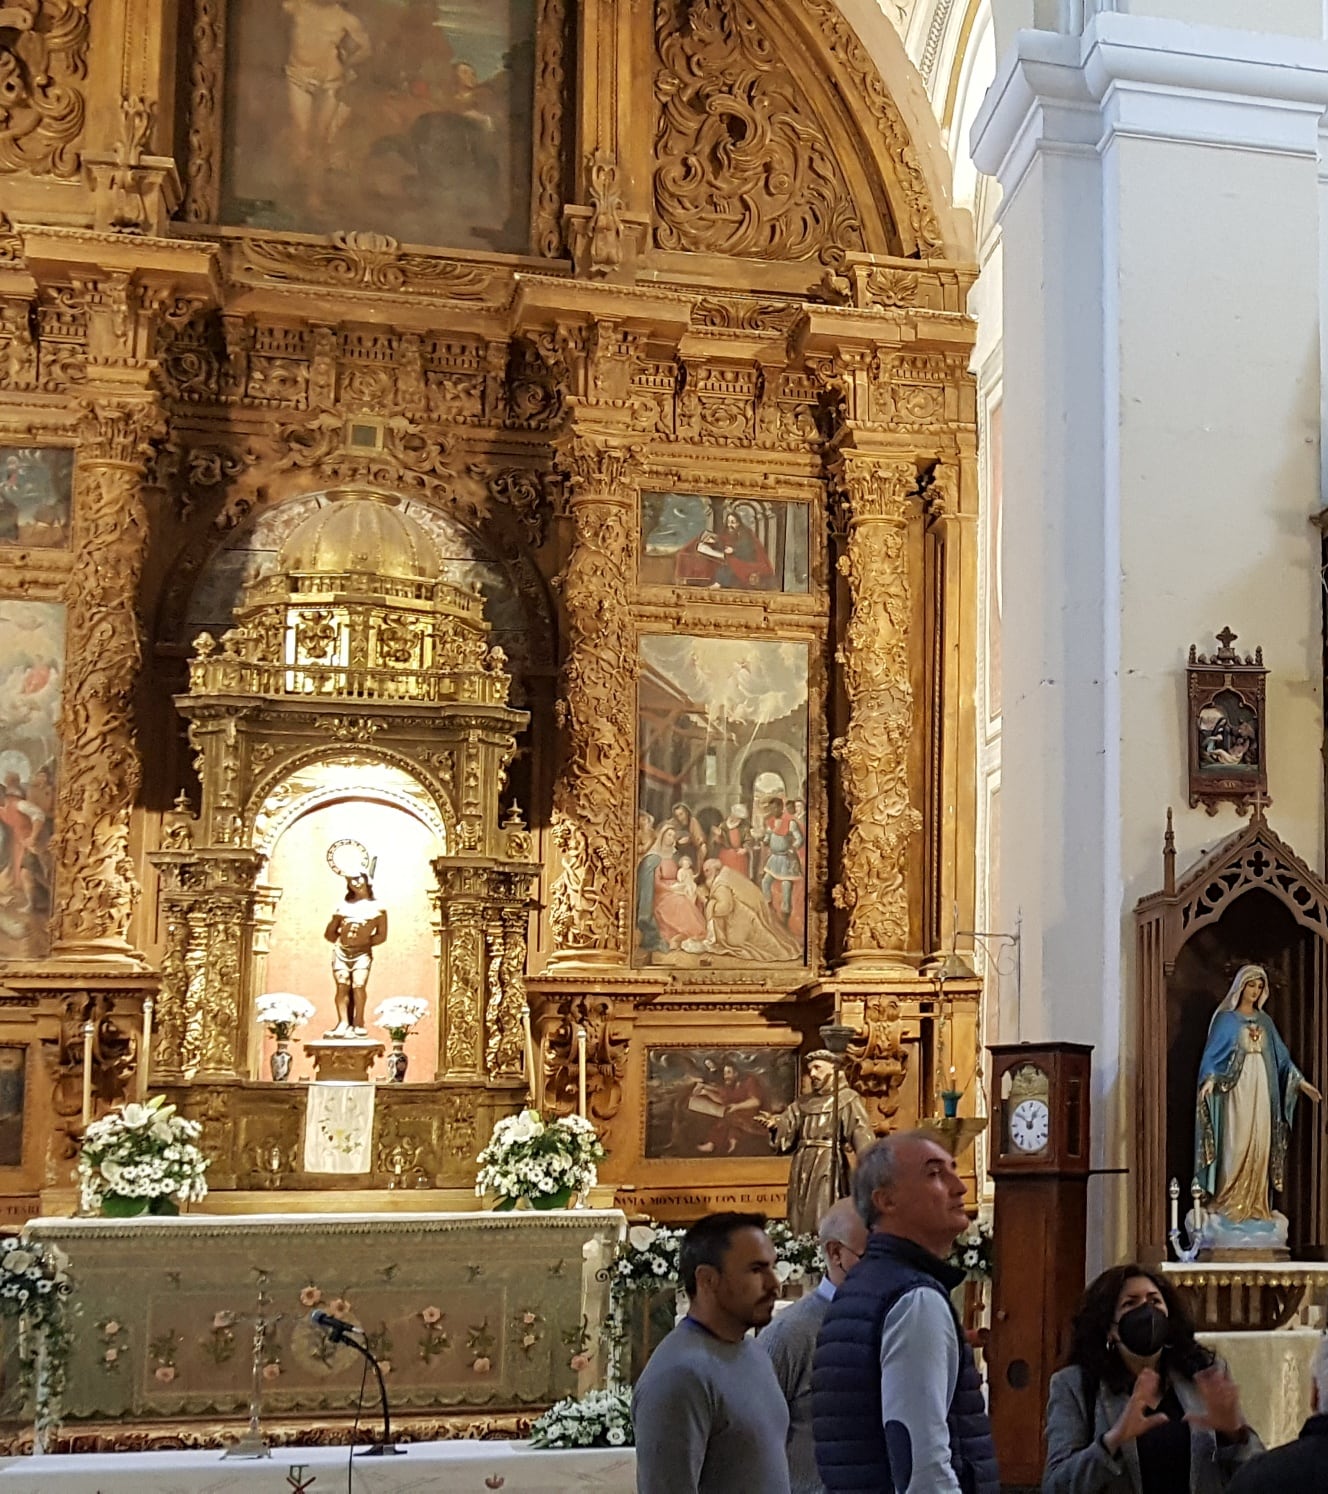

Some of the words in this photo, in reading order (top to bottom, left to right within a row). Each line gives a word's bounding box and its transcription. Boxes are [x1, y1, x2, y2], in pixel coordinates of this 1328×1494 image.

[650, 1194, 711, 1205] MONTALVO
[715, 1194, 736, 1203] CON
[740, 1193, 752, 1203] EL
